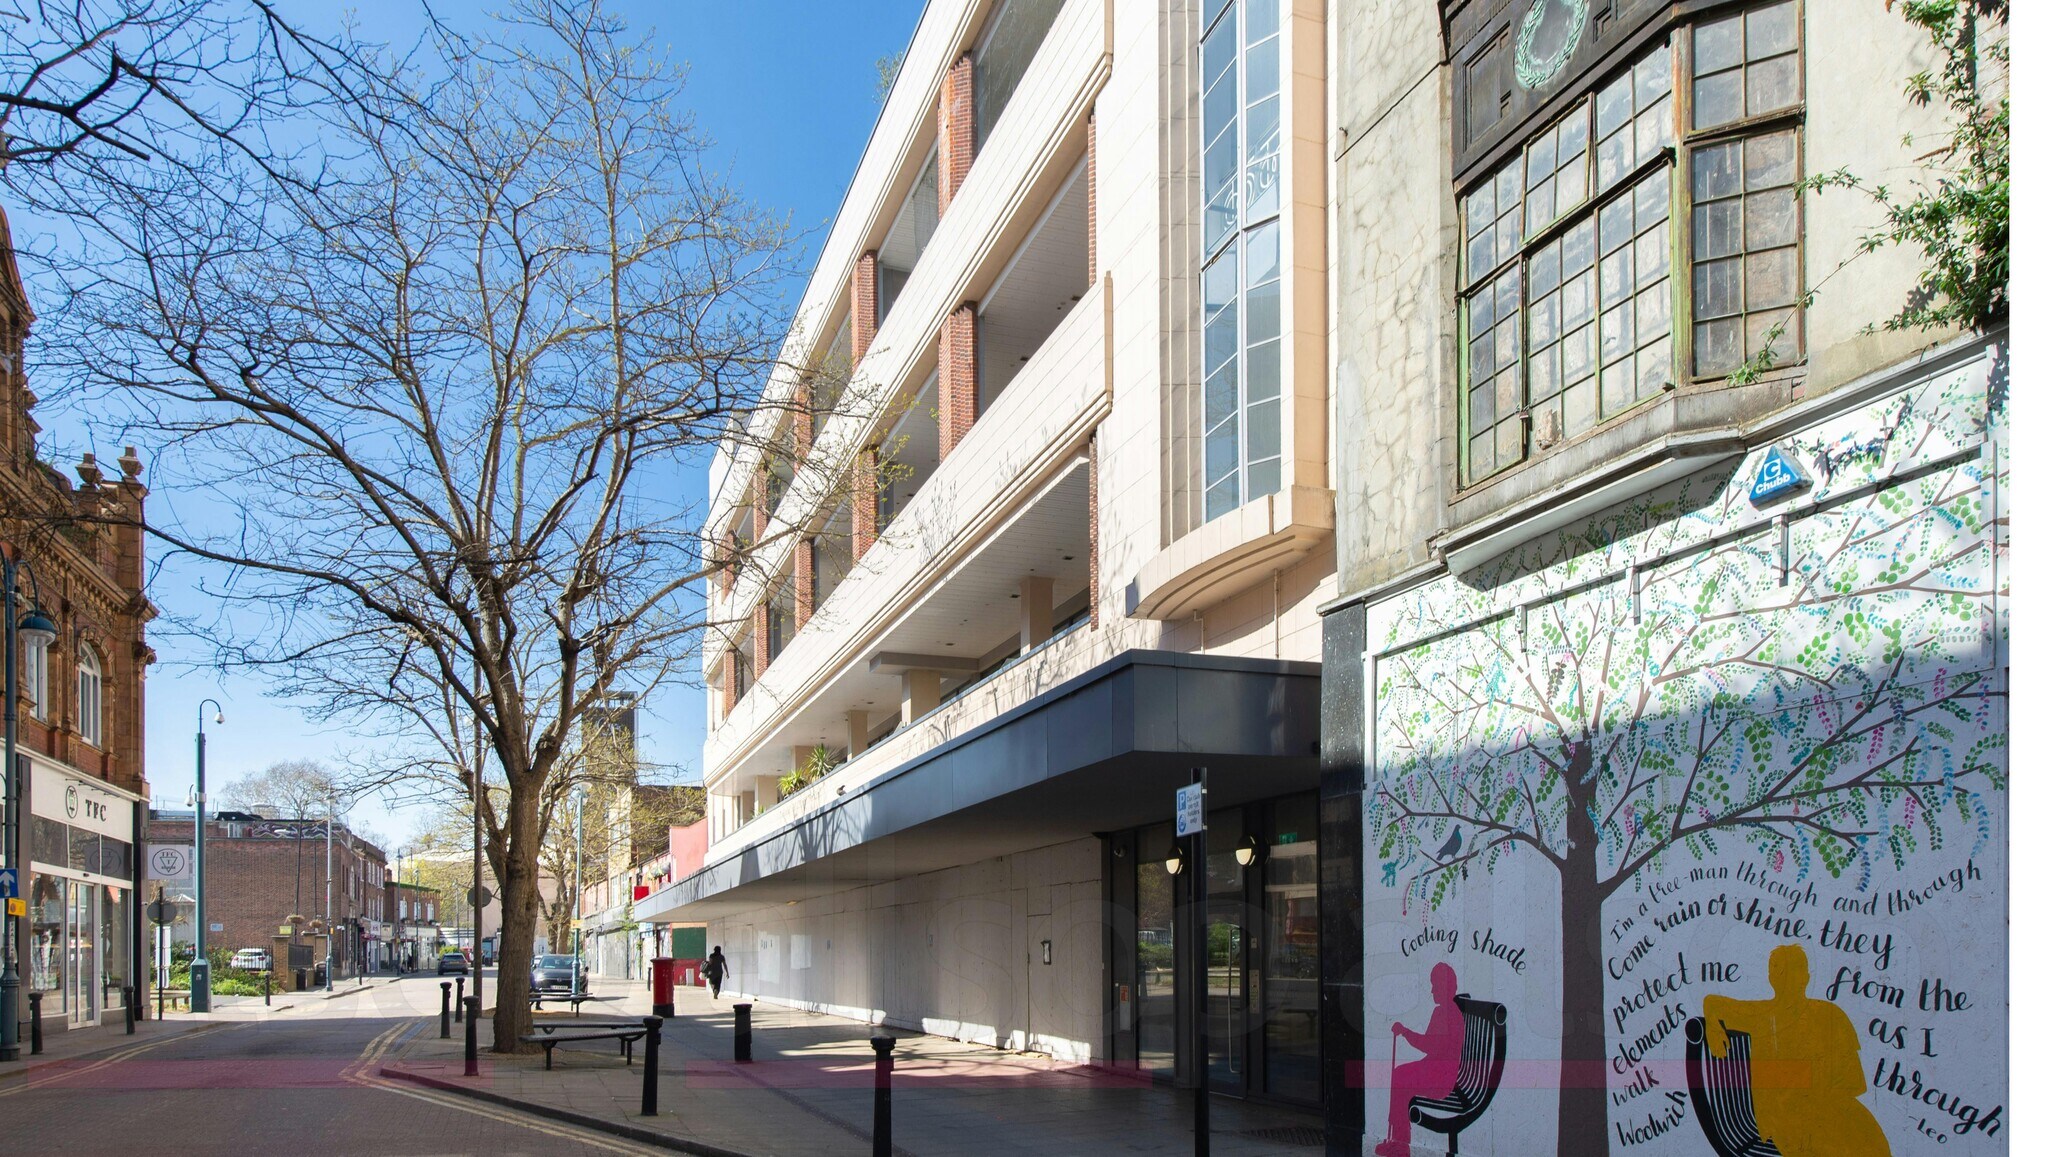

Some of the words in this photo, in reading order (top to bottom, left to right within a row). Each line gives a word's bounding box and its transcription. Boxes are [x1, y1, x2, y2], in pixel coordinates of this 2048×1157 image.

[1755, 473, 1791, 494] Chubb
[85, 799, 107, 822] TFC
[1638, 902, 1649, 917] a
[1649, 866, 1728, 904] tree-man
[1737, 860, 1818, 913] through
[1834, 892, 1878, 916] and
[1888, 858, 1982, 916] through
[1401, 925, 1459, 958] Cooling
[1608, 934, 1656, 981] Come
[1654, 901, 1702, 932] rain
[1707, 893, 1727, 916] or
[1820, 919, 1895, 971] they
[1613, 952, 1693, 1034] protect
[1701, 961, 1742, 982] me
[1826, 966, 1905, 1008] from
[1919, 978, 1973, 1012] the
[1613, 1002, 1687, 1075] elements
[1868, 1018, 1907, 1050] as
[1919, 1028, 1938, 1057] I
[1613, 1066, 1659, 1106] walk
[1873, 1057, 2003, 1138] through
[1616, 1090, 1688, 1147] Woolwich
